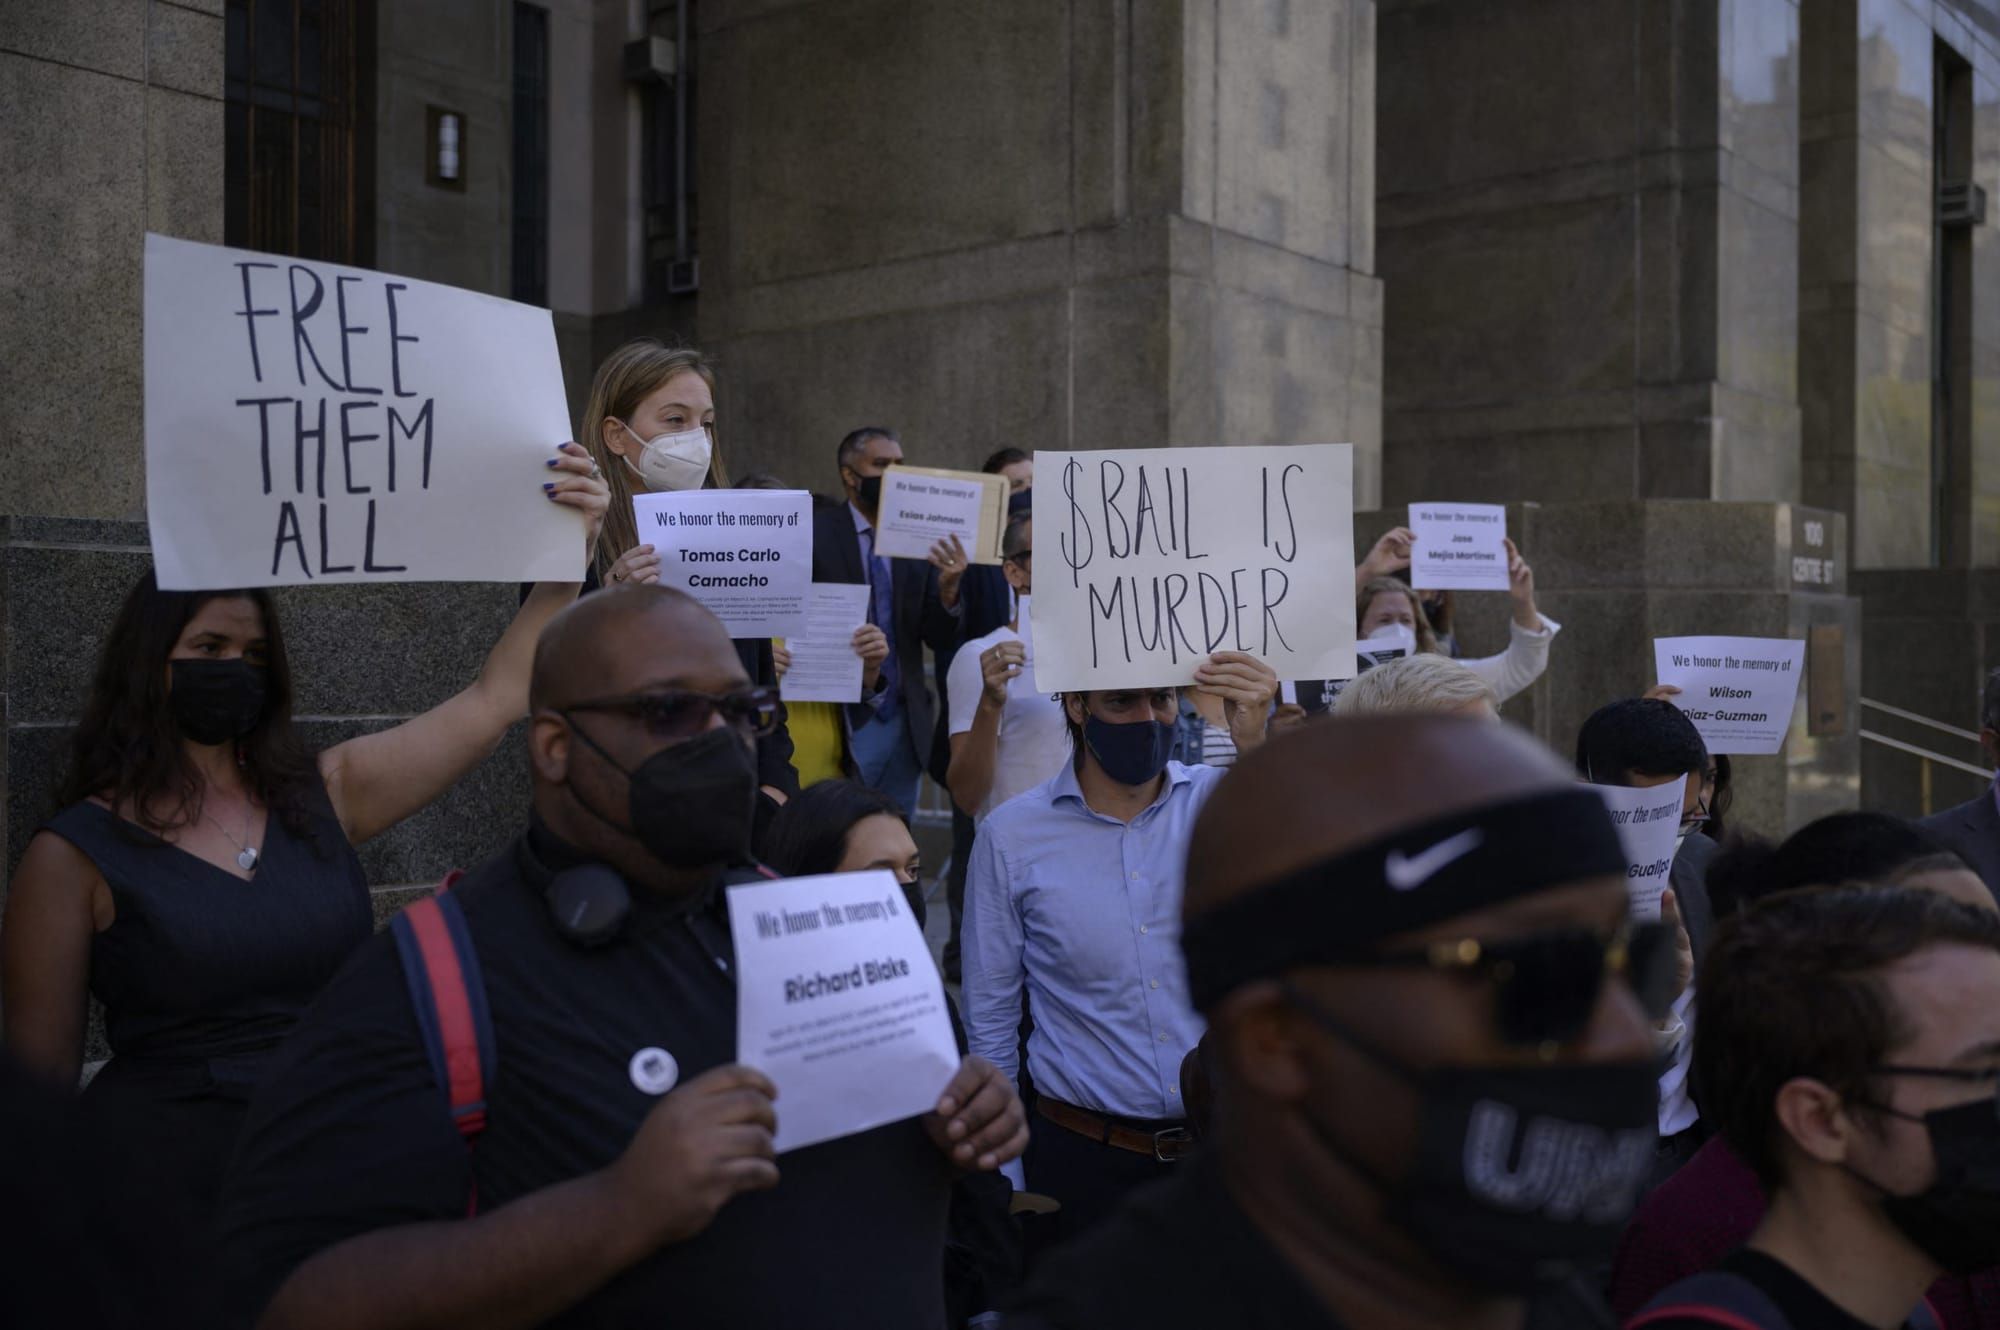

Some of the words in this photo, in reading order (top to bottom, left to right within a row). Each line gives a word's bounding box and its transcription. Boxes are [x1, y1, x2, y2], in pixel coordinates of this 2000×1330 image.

[234, 262, 420, 397] FREE
[235, 397, 434, 499] THEM
[656, 512, 676, 527] We
[679, 511, 713, 526] honor
[717, 511, 736, 526] the
[739, 514, 784, 528] memory
[787, 512, 799, 526] of
[1261, 463, 1304, 562] IS
[272, 499, 407, 578] ALL
[679, 549, 734, 562] Tomas
[738, 548, 781, 562] Carlo
[688, 574, 769, 588] Camacho
[1088, 567, 1295, 669] MURDER
[1672, 654, 1691, 668] We
[1693, 654, 1722, 669] honor
[1725, 656, 1740, 669] the
[1742, 660, 1779, 673] memory
[1781, 658, 1792, 672] of
[1709, 686, 1752, 699] Wilson
[1632, 805, 1650, 824] the
[756, 912, 781, 938] We
[782, 908, 821, 935] honor
[823, 902, 844, 927] the
[785, 964, 864, 1004] Richard
[863, 956, 910, 985] Blake
